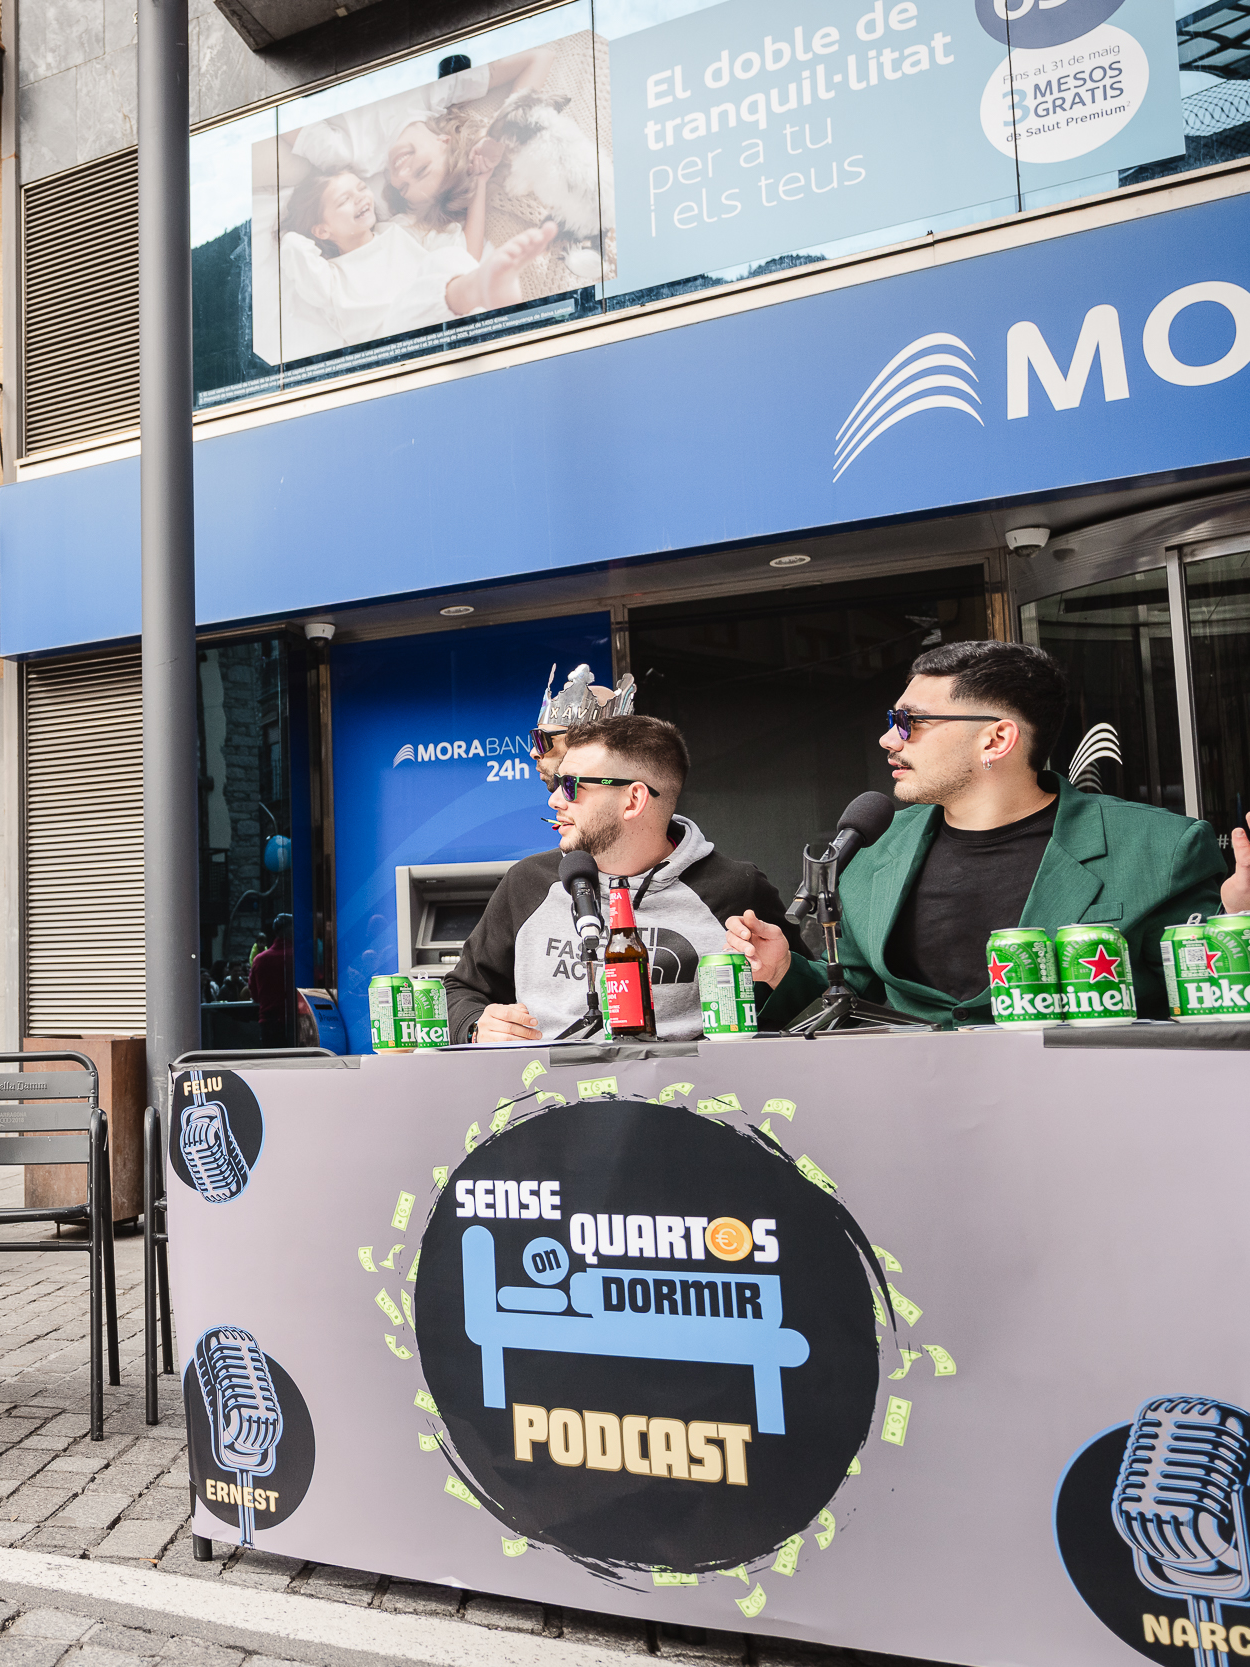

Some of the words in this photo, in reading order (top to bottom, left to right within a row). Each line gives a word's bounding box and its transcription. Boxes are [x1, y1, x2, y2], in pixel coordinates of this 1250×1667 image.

[646, 64, 691, 110] El
[704, 25, 840, 89] doble
[856, 0, 918, 41] de
[1003, 71, 1029, 85] Fins
[1033, 64, 1045, 76] al
[1051, 59, 1064, 72] 31
[1068, 54, 1084, 66] de
[1088, 44, 1121, 60] maig
[1002, 88, 1031, 127] 3
[1033, 60, 1123, 100] MESOS
[1034, 80, 1124, 119] GRATIS
[1006, 131, 1022, 143] de
[1026, 120, 1062, 138] Salut
[649, 149, 722, 206] per
[739, 138, 764, 168] a
[783, 117, 833, 154] tu
[650, 205, 656, 237] i
[673, 187, 742, 229] els
[758, 154, 866, 207] teus
[550, 705, 598, 720] XAVI
[417, 735, 531, 763] MORABAN
[486, 758, 530, 782] 24h
[17, 1081, 48, 1092] Damm
[183, 1076, 223, 1097] FELIU
[455, 1179, 562, 1221] SENSE
[601, 1275, 764, 1320] DORMIR
[512, 1402, 753, 1487] PODCAST
[206, 1478, 280, 1513] ERNEST
